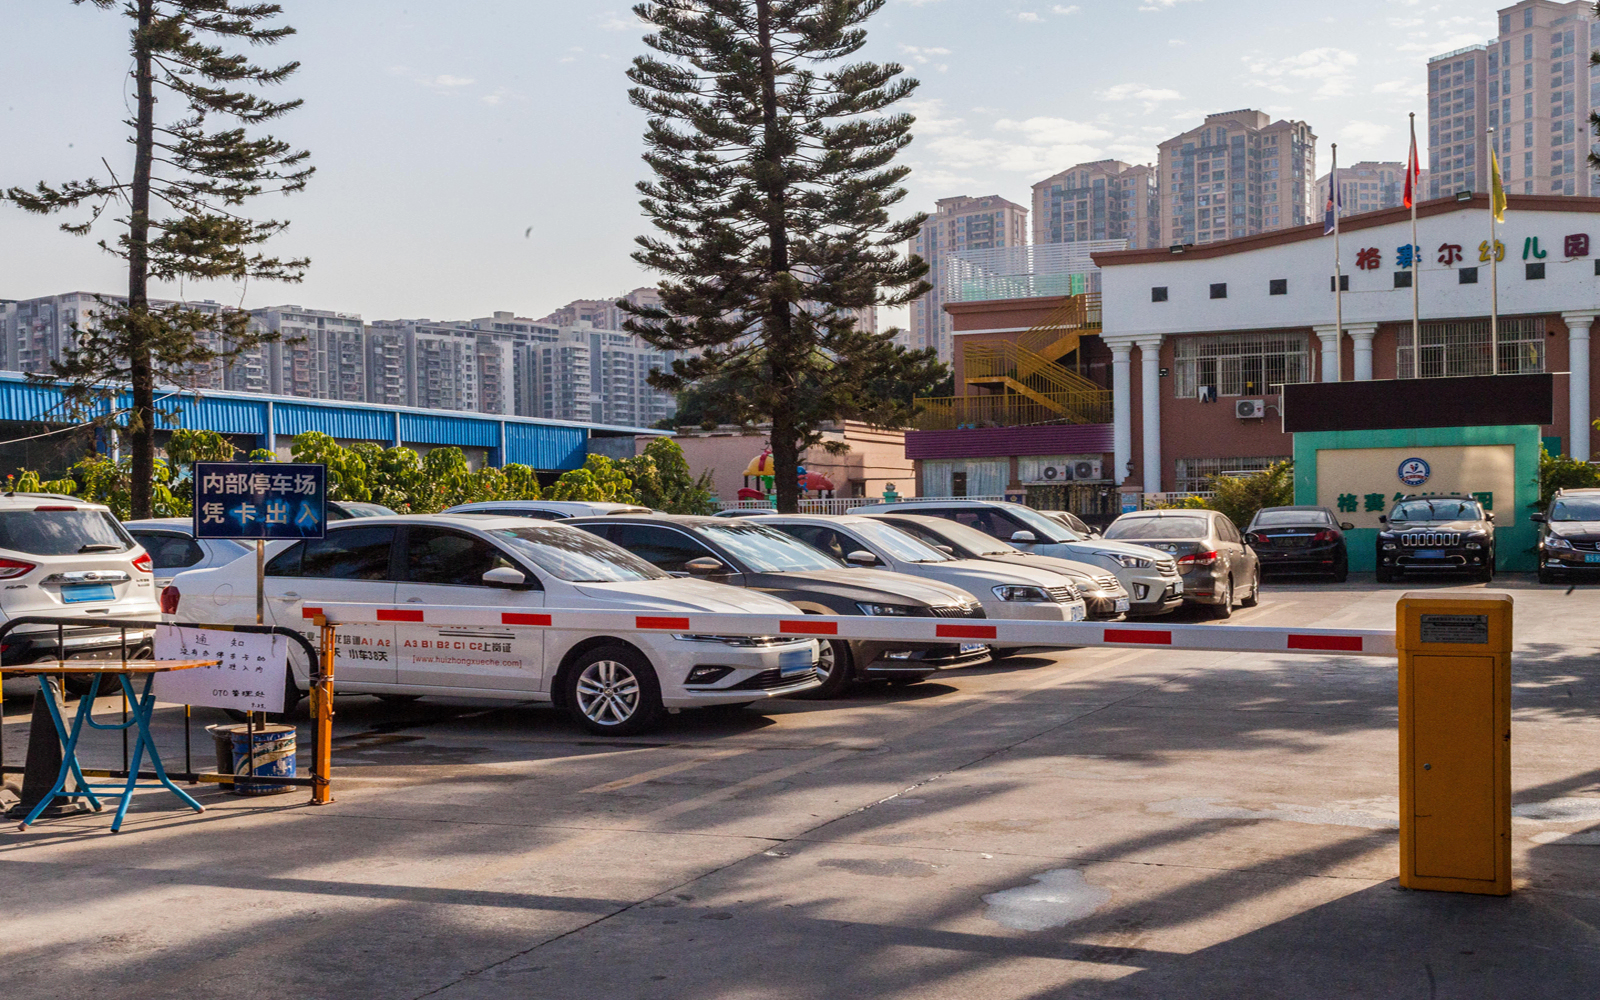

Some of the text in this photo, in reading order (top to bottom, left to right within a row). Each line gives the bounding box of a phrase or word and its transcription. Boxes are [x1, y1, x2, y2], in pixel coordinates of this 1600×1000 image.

[1356, 233, 1589, 270] 格赛尔幼儿园
[203, 472, 316, 495] 内部停车场
[202, 502, 319, 524] 凭卡出入
[195, 633, 245, 646] 通知
[377, 638, 391, 647] A2
[403, 640, 418, 648] A3
[421, 640, 433, 648] B1
[436, 641, 450, 649] B2
[453, 641, 465, 650] C1
[348, 649, 389, 662] 小车38天
